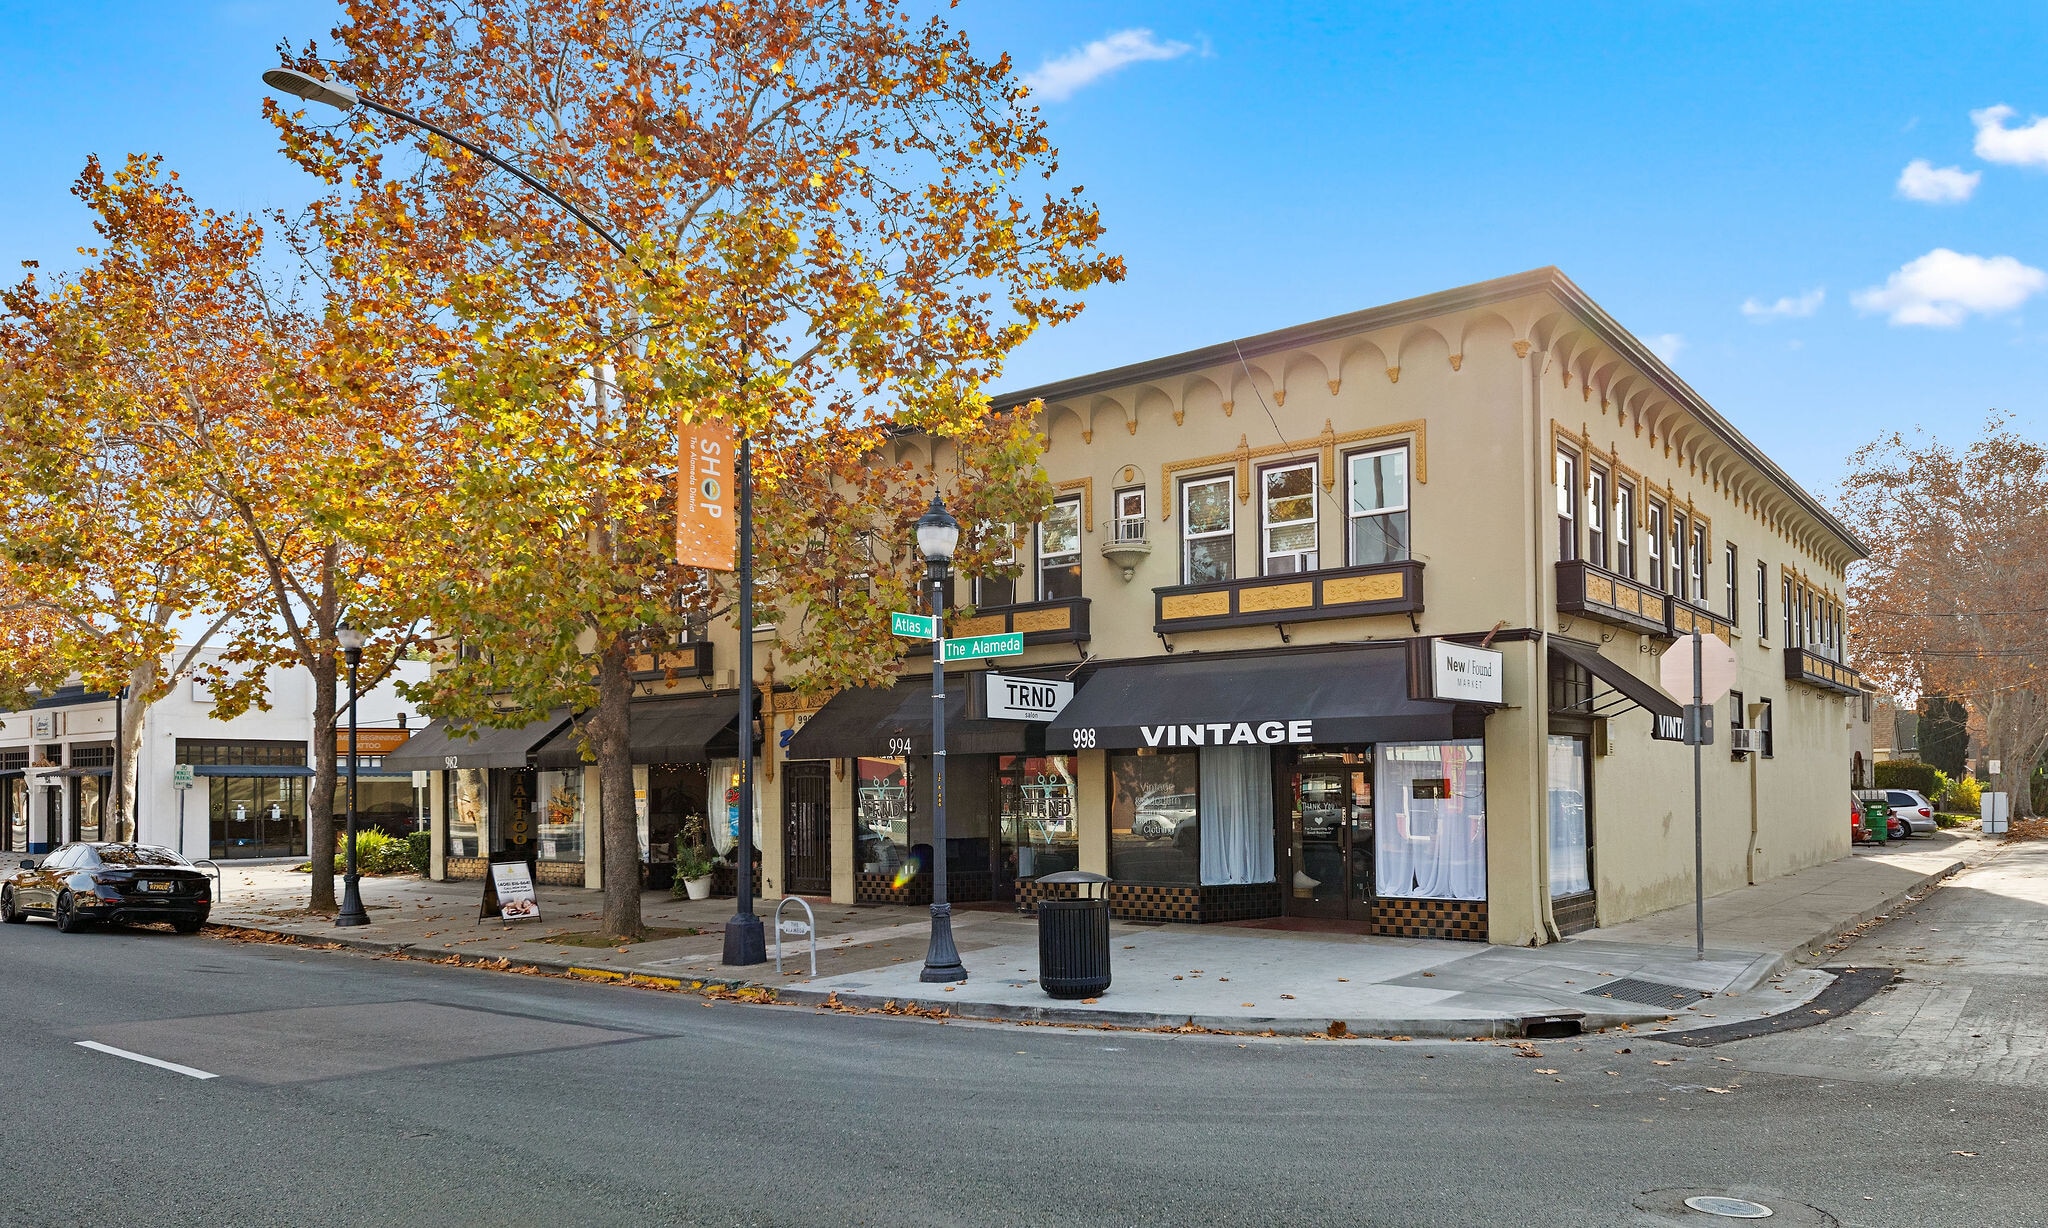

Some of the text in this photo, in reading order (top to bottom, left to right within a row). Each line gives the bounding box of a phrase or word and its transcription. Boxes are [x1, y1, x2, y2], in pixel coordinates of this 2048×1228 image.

[689, 451, 698, 485] Alameda
[700, 438, 722, 518] SHOP
[689, 487, 697, 513] District
[894, 616, 921, 634] Atlas
[946, 637, 1021, 657] The Alameda
[1446, 655, 1466, 673] New
[1472, 660, 1492, 677] Found
[1457, 678, 1483, 689] MARKET
[1006, 684, 1056, 708] TRND
[1024, 711, 1039, 719] salon
[360, 734, 402, 742] BEGINNINGS
[1072, 728, 1096, 749] 998
[1139, 719, 1313, 747] VINTAGE
[889, 737, 912, 755] 994
[445, 756, 458, 769] 982
[1139, 782, 1176, 793] Vintage
[511, 773, 528, 845] TATTOO
[862, 800, 902, 818] TRND
[1025, 800, 1071, 817] TRND
[1302, 801, 1321, 811] THANK
[1143, 825, 1175, 835] Clothing
